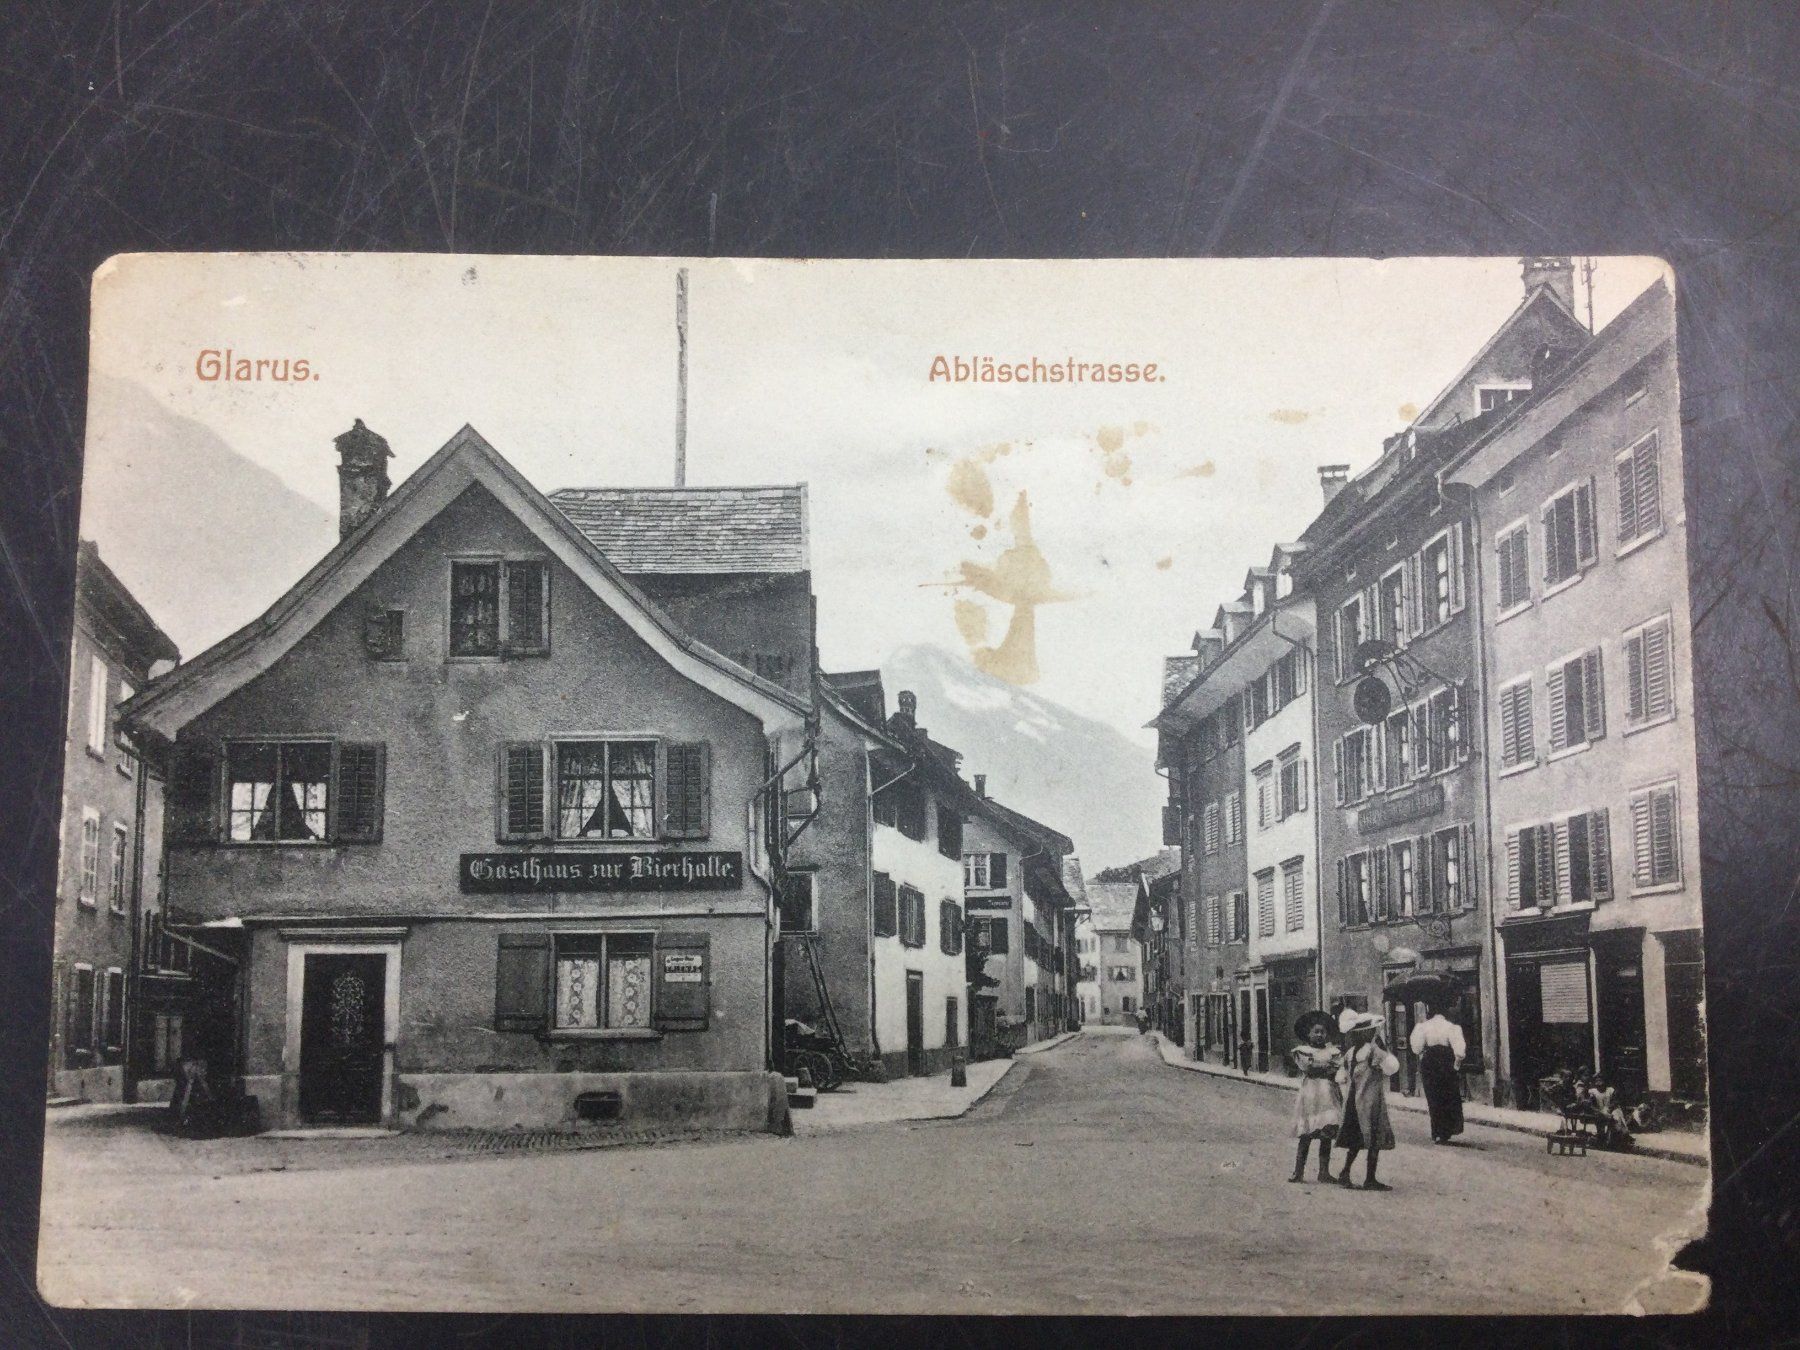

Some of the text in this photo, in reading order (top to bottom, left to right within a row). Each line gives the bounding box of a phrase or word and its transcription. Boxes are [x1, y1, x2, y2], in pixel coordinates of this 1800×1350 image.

[196, 349, 320, 382] Glarus.
[929, 355, 1166, 383] Abläschstrasse.
[469, 857, 581, 884] Gasthaus
[588, 863, 622, 881] zur
